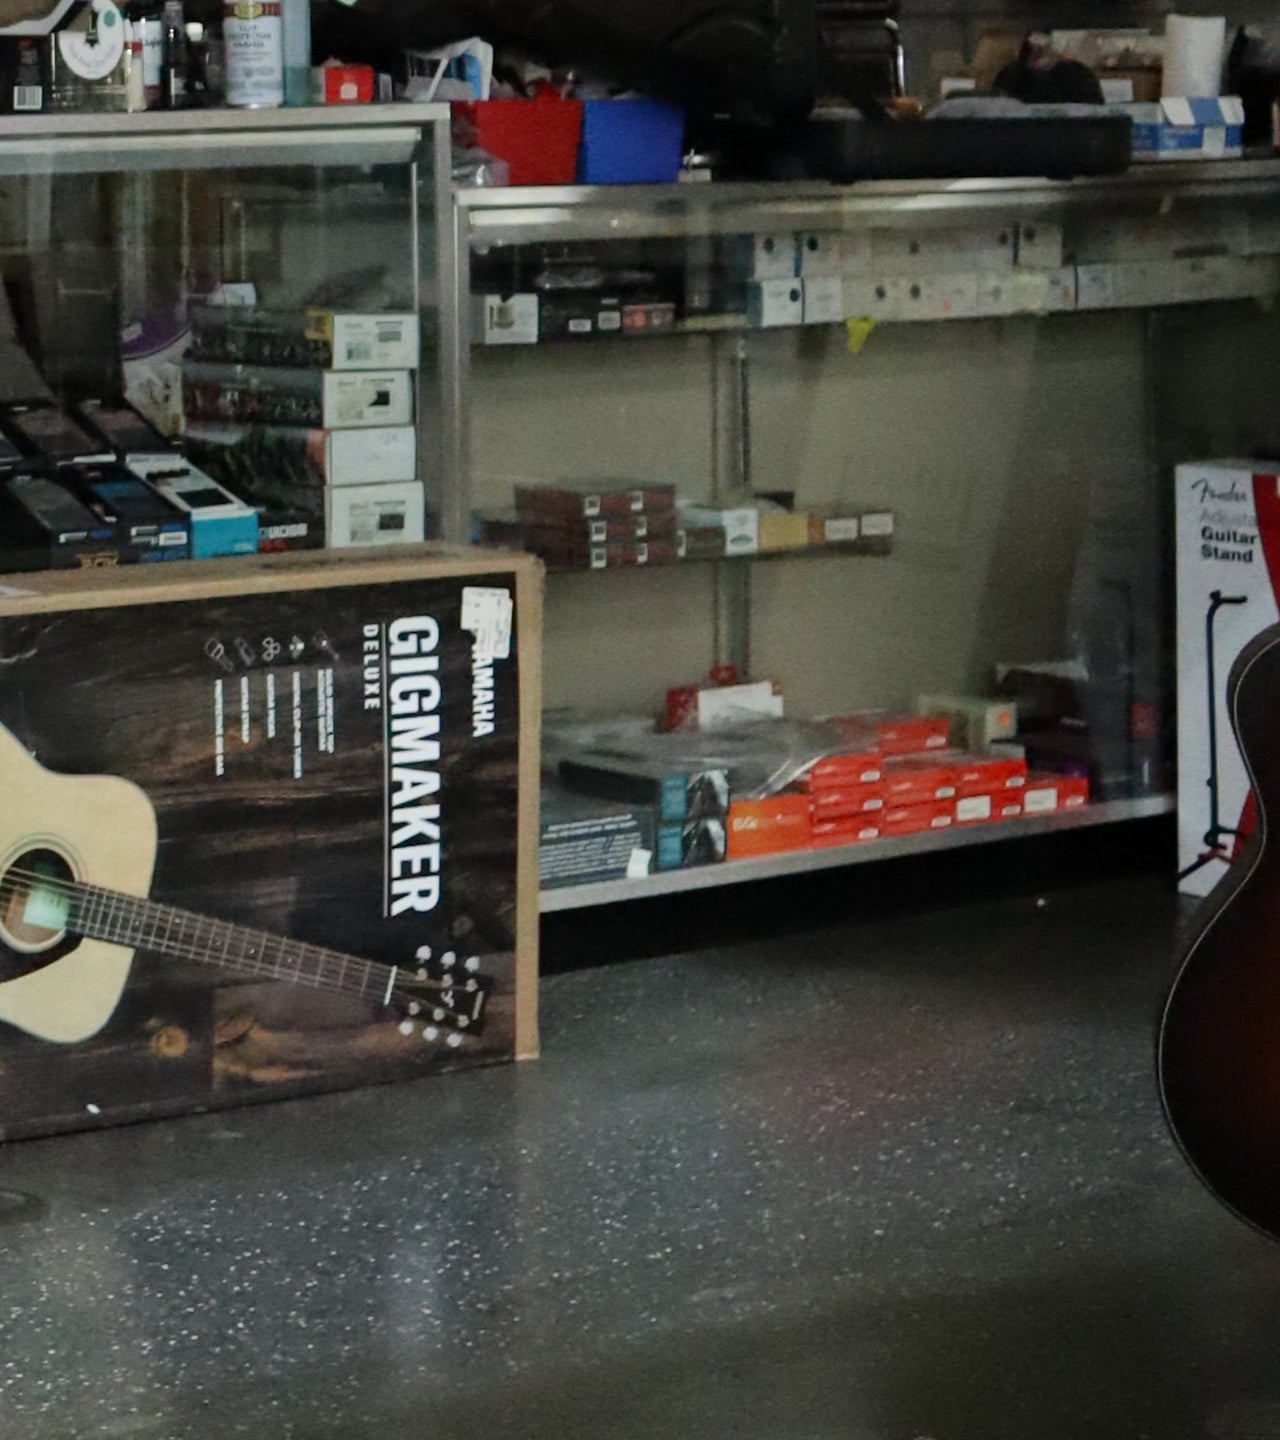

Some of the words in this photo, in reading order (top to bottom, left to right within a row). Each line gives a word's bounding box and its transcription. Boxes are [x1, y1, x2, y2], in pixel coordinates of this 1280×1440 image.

[1201, 525, 1257, 545] Guitar
[1201, 544, 1253, 563] Stand
[363, 623, 380, 710] DELUXE
[389, 615, 441, 917] GIGMAKER
